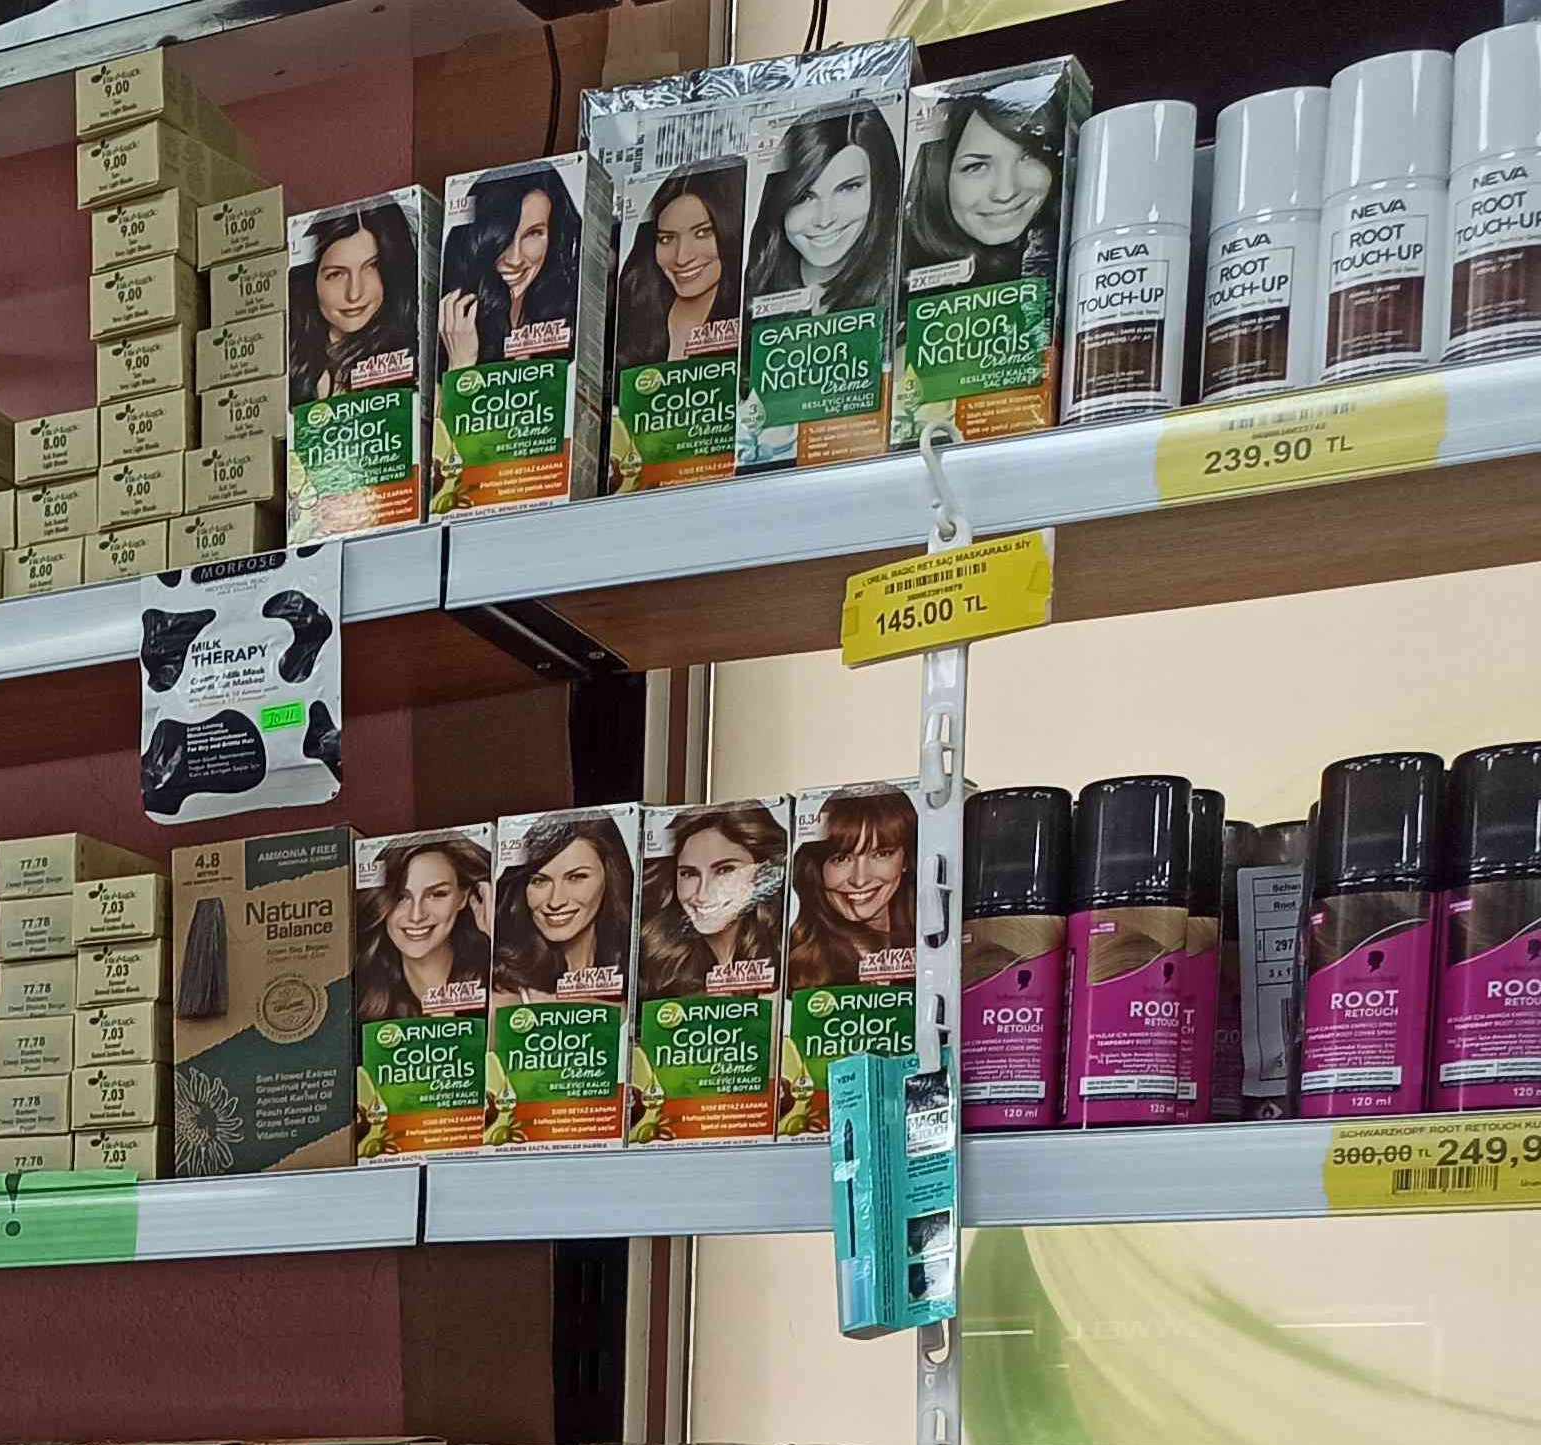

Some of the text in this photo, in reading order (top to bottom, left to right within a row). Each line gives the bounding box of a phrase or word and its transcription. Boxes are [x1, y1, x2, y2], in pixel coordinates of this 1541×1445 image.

[1472, 166, 1528, 189] NEVA
[1471, 191, 1527, 218] ROOT
[1221, 233, 1271, 256] NEVA
[1349, 224, 1405, 249] ROOT
[1095, 268, 1148, 290] ROOT
[1220, 257, 1270, 283] ROOT
[916, 284, 1038, 320] GARNIER
[1078, 287, 1165, 315] TOUCH-UP
[1207, 275, 1289, 306] TOUCH-UP
[456, 363, 555, 394] GARNIER
[1204, 436, 1353, 476] 239.90 TL
[876, 596, 988, 636] 145.00 TL
[191, 640, 221, 652] MILK
[191, 644, 268, 668] THERAPY
[195, 852, 220, 870] 4.8
[1345, 1006, 1399, 1019] RETOUCH
[376, 1020, 473, 1045] GARNIER
[525, 1029, 592, 1052] Color
[1352, 1096, 1391, 1106] 120 ml
[1429, 1125, 1460, 1134] ROOT
[1418, 1149, 1431, 1158] TL
[1437, 1134, 1541, 1169] 249,9
